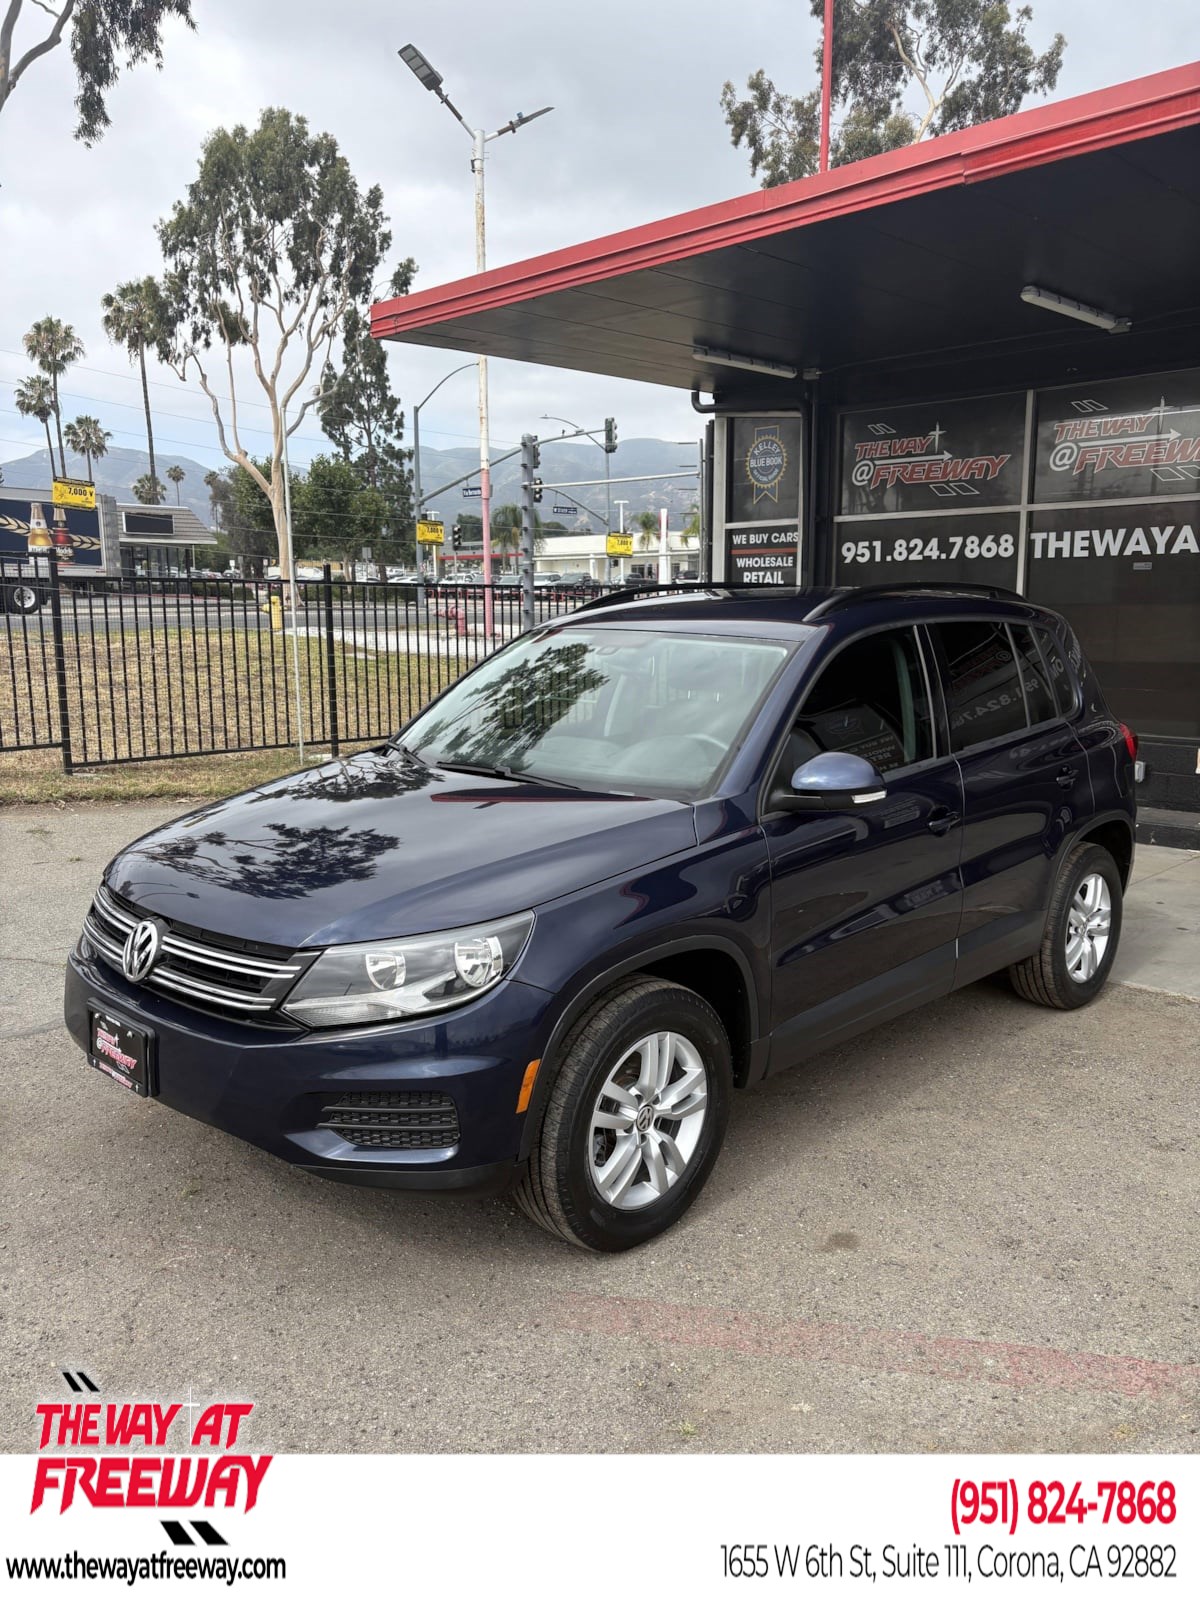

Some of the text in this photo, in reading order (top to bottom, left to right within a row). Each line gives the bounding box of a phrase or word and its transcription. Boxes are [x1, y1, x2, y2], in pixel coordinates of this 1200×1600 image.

[1054, 414, 1155, 443] THE WAY
[753, 441, 781, 456] KELLEY
[855, 435, 936, 461] THE WAY
[750, 456, 783, 468] BLUE BOOK
[68, 487, 87, 496] 7,000
[732, 532, 799, 545] WE BUY CARS
[1030, 525, 1200, 558] THEWAYA
[841, 533, 1015, 564] 951.824.7868
[736, 556, 794, 568] WHOLESALE
[743, 571, 785, 584] RETAIL
